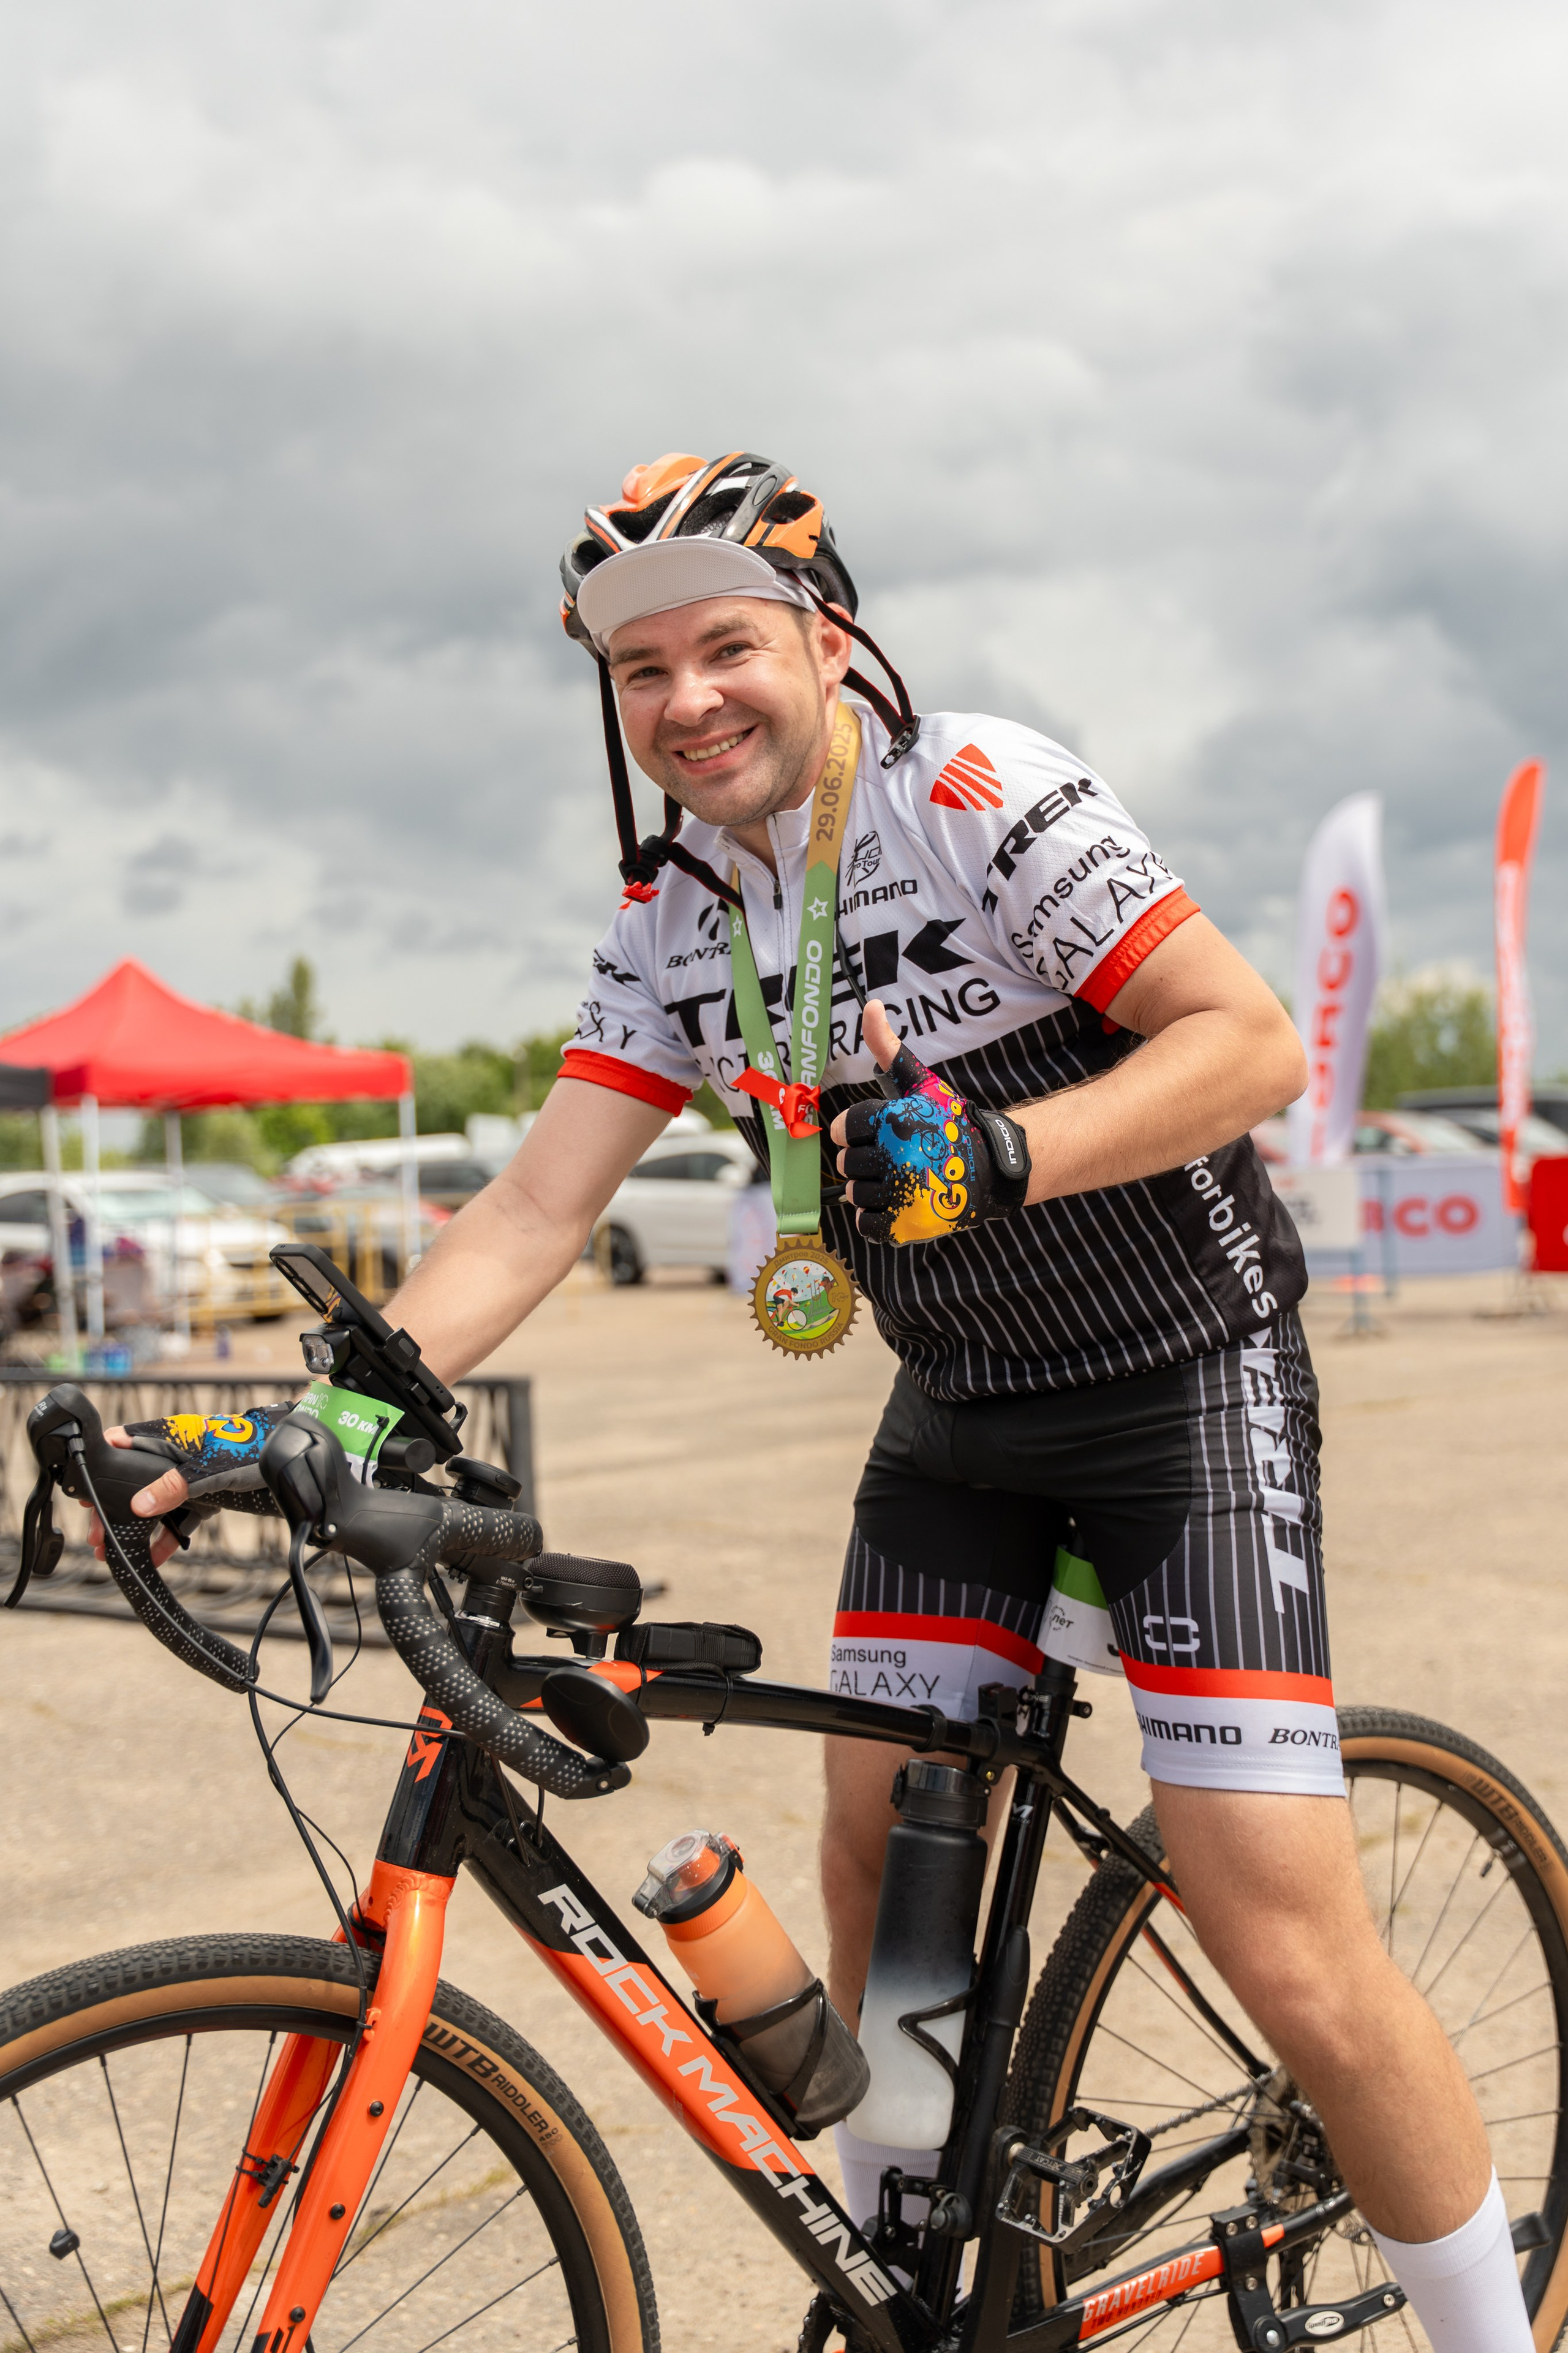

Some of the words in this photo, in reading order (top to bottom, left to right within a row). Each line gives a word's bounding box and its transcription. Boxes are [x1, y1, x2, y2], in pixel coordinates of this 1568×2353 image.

[816, 723, 853, 842] 29.06.2025
[839, 879, 918, 919] HIMANO
[966, 1135, 976, 1182] INDIGO
[995, 1119, 1017, 1165] INDIGO
[774, 1251, 809, 1267] Дмитров
[810, 1251, 830, 1264] 2025
[767, 1325, 788, 1345] GRAN
[789, 1340, 818, 1349] FONDO
[821, 1322, 844, 1345] RUSSIA
[337, 1410, 360, 1428] 30
[832, 1644, 905, 1668] Samsung
[1136, 1711, 1242, 1745] HIMANO
[423, 2022, 500, 2079] WTB
[491, 2073, 549, 2134] RIDDLER
[537, 1883, 694, 2058] ROCK
[676, 2054, 899, 2308] MACHINE
[1082, 2253, 1205, 2322] GRAVELRIDE
